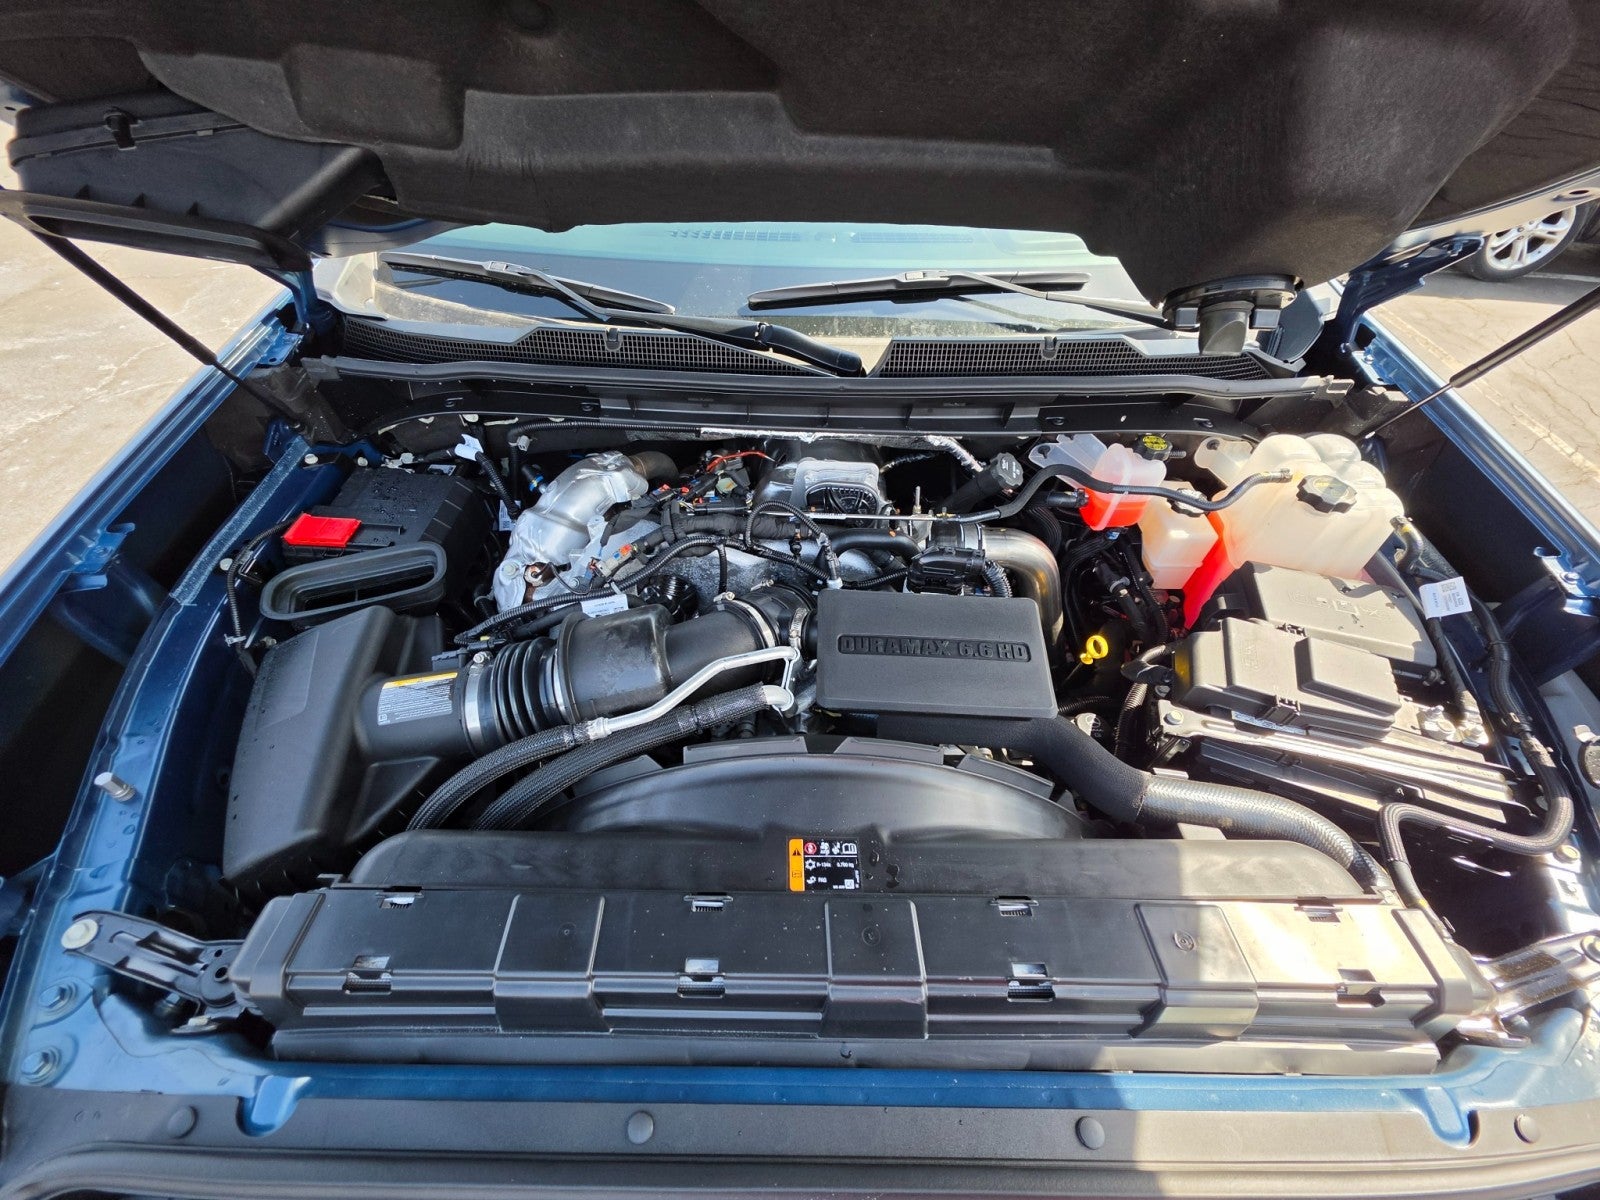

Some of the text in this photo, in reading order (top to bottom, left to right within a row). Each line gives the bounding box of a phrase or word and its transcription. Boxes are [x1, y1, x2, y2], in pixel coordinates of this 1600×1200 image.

[841, 636, 1029, 660] DURAMAX 6.6 HD
